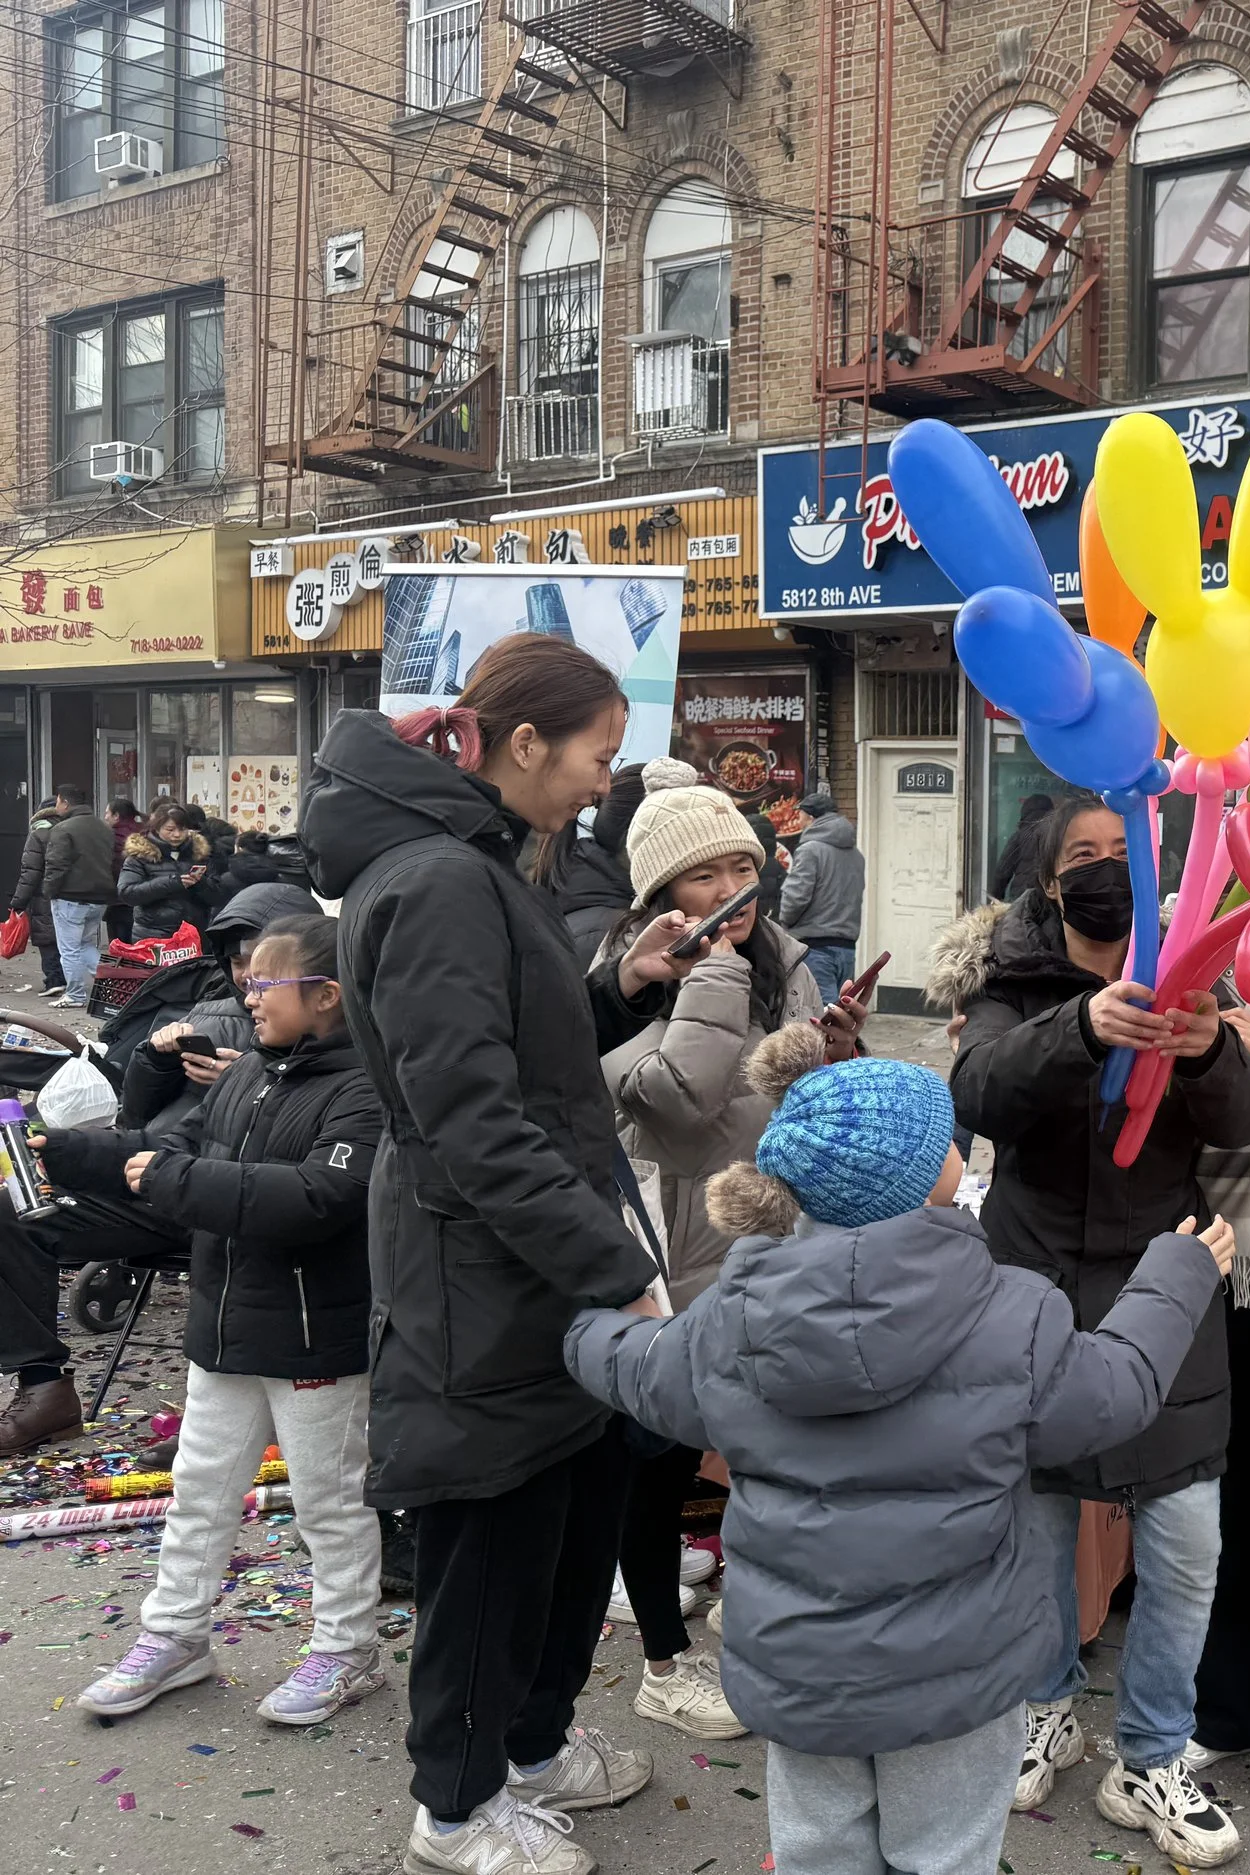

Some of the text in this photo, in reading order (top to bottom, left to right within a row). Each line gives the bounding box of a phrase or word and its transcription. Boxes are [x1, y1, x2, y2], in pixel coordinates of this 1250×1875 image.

[254, 551, 280, 573] 早餐
[781, 584, 882, 608] 5812 8th AVE
[11, 623, 60, 643] BAKERY
[263, 635, 290, 648] 5814
[685, 694, 805, 723] 晚餐海鲜大排档
[733, 726, 757, 735] Seafood
[757, 726, 775, 734] Dinner
[906, 773, 945, 787] 5812
[21, 1513, 51, 1530] 24
